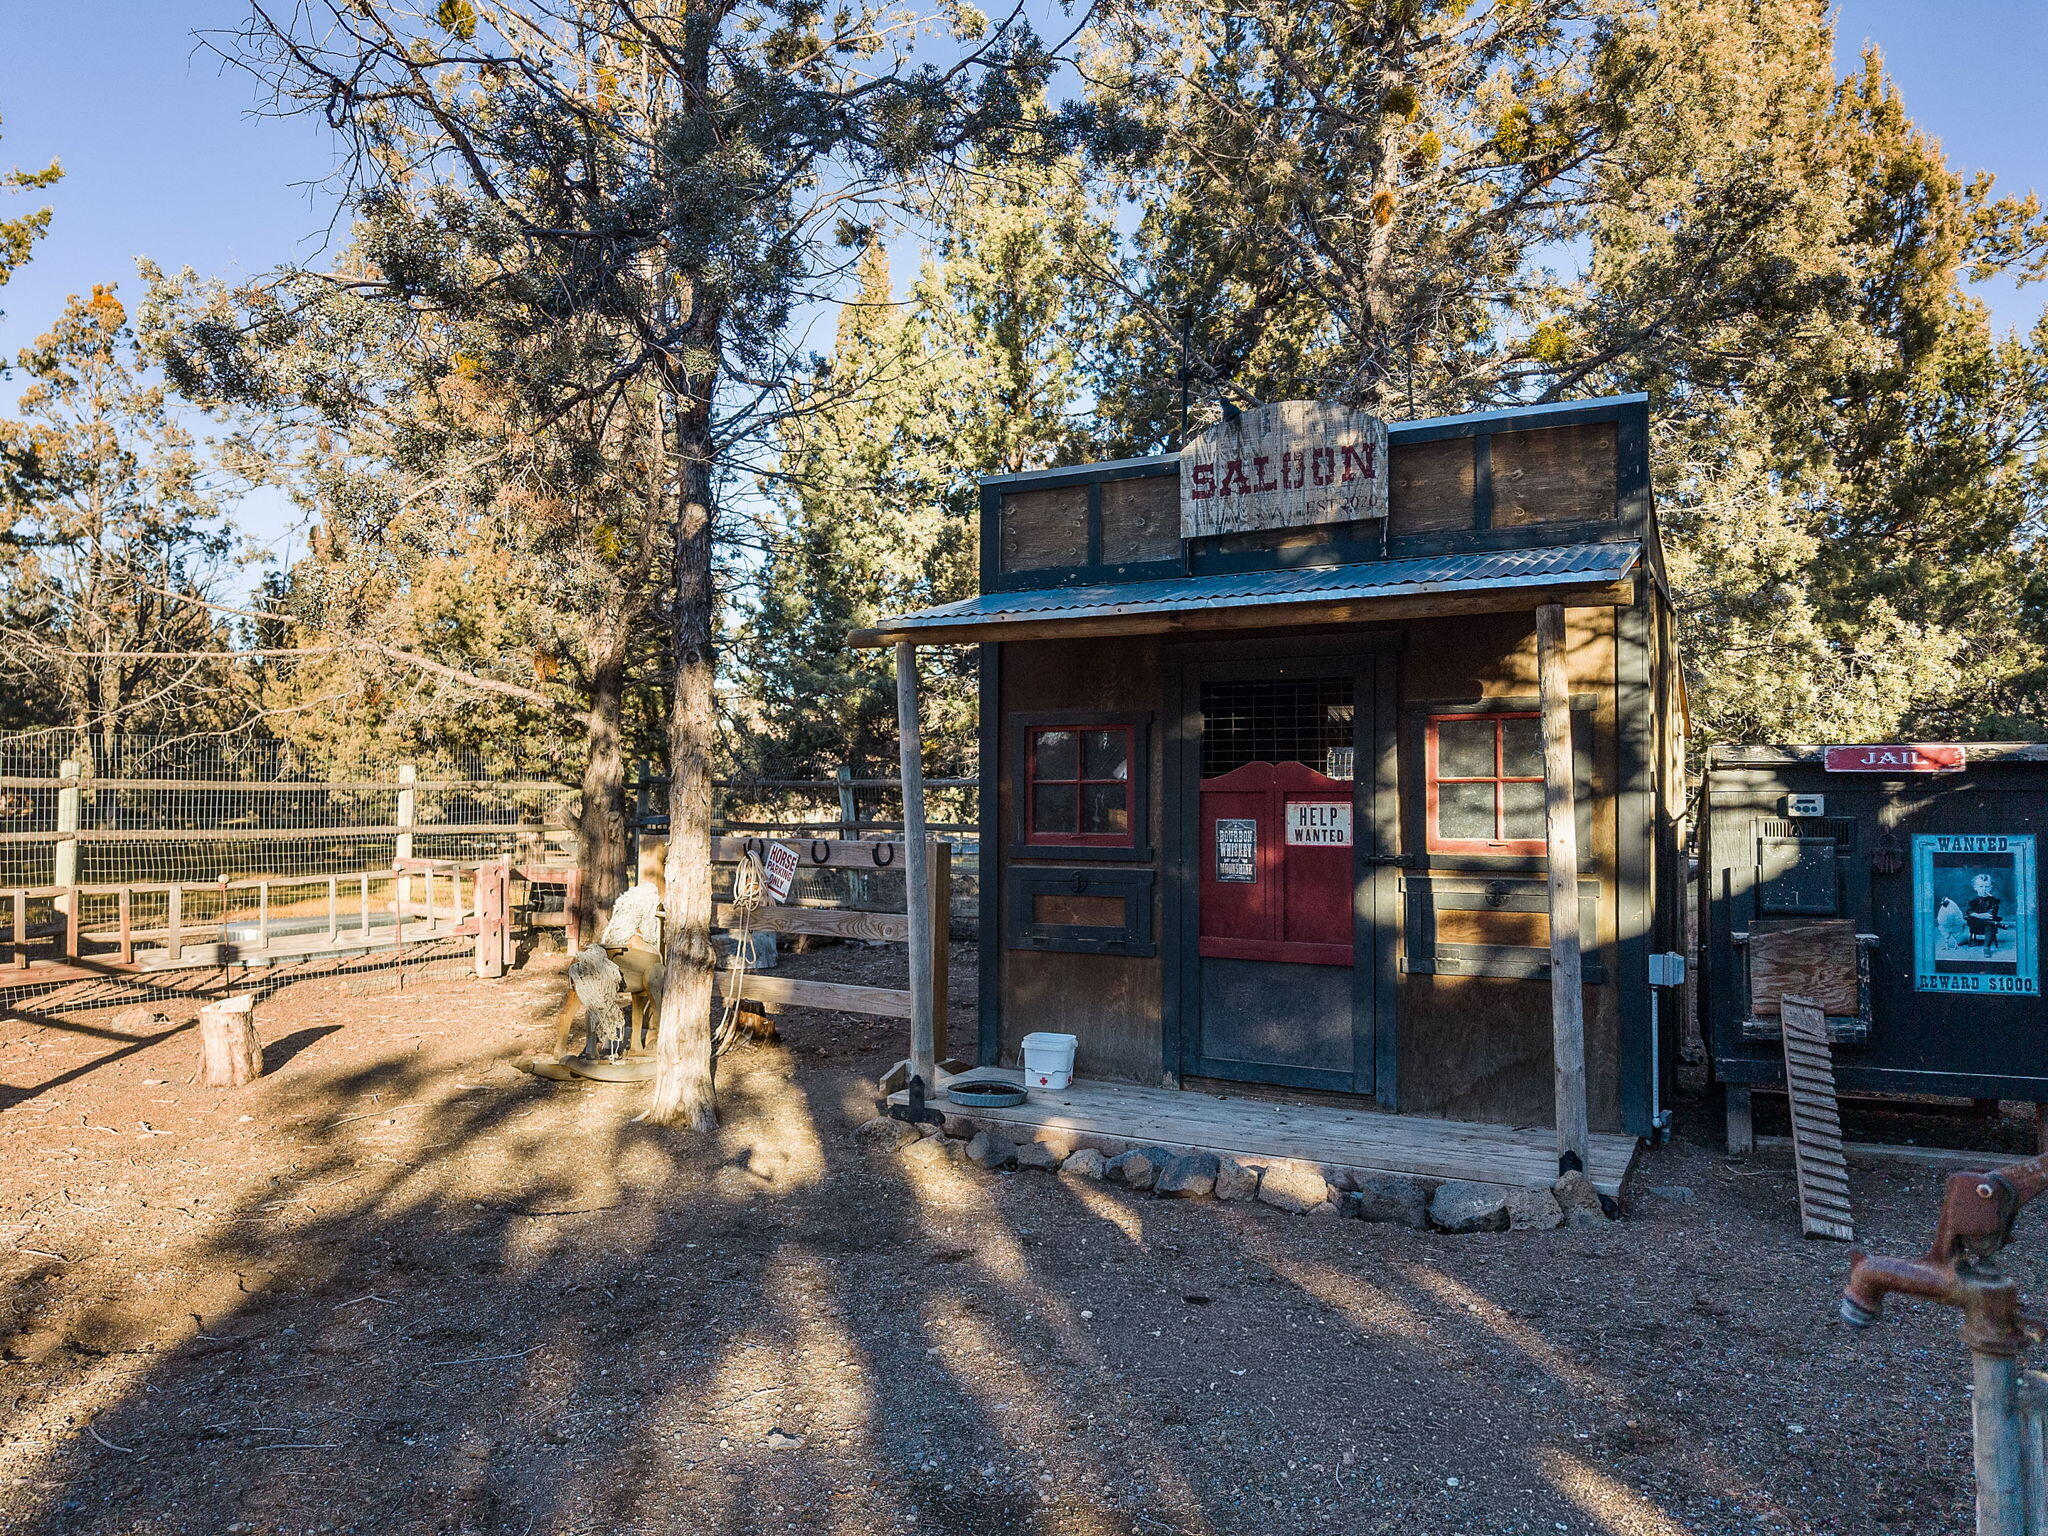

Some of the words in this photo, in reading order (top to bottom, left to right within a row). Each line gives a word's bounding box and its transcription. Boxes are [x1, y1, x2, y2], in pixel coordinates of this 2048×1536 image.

[1192, 443, 1376, 500] SALOON
[1860, 752, 1929, 765] JAIL
[1300, 807, 1338, 826] HELP
[1219, 830, 1253, 843] BOURBON
[1294, 829, 1344, 843] WANTED
[1220, 843, 1252, 857] WHISKEY
[1937, 837, 2008, 851] WANTED
[770, 846, 797, 871] HORSE
[767, 861, 792, 881] PARKING
[1219, 863, 1253, 875] MOONSHINE
[769, 873, 785, 889] ONLY
[1920, 975, 1980, 989] REWARD
